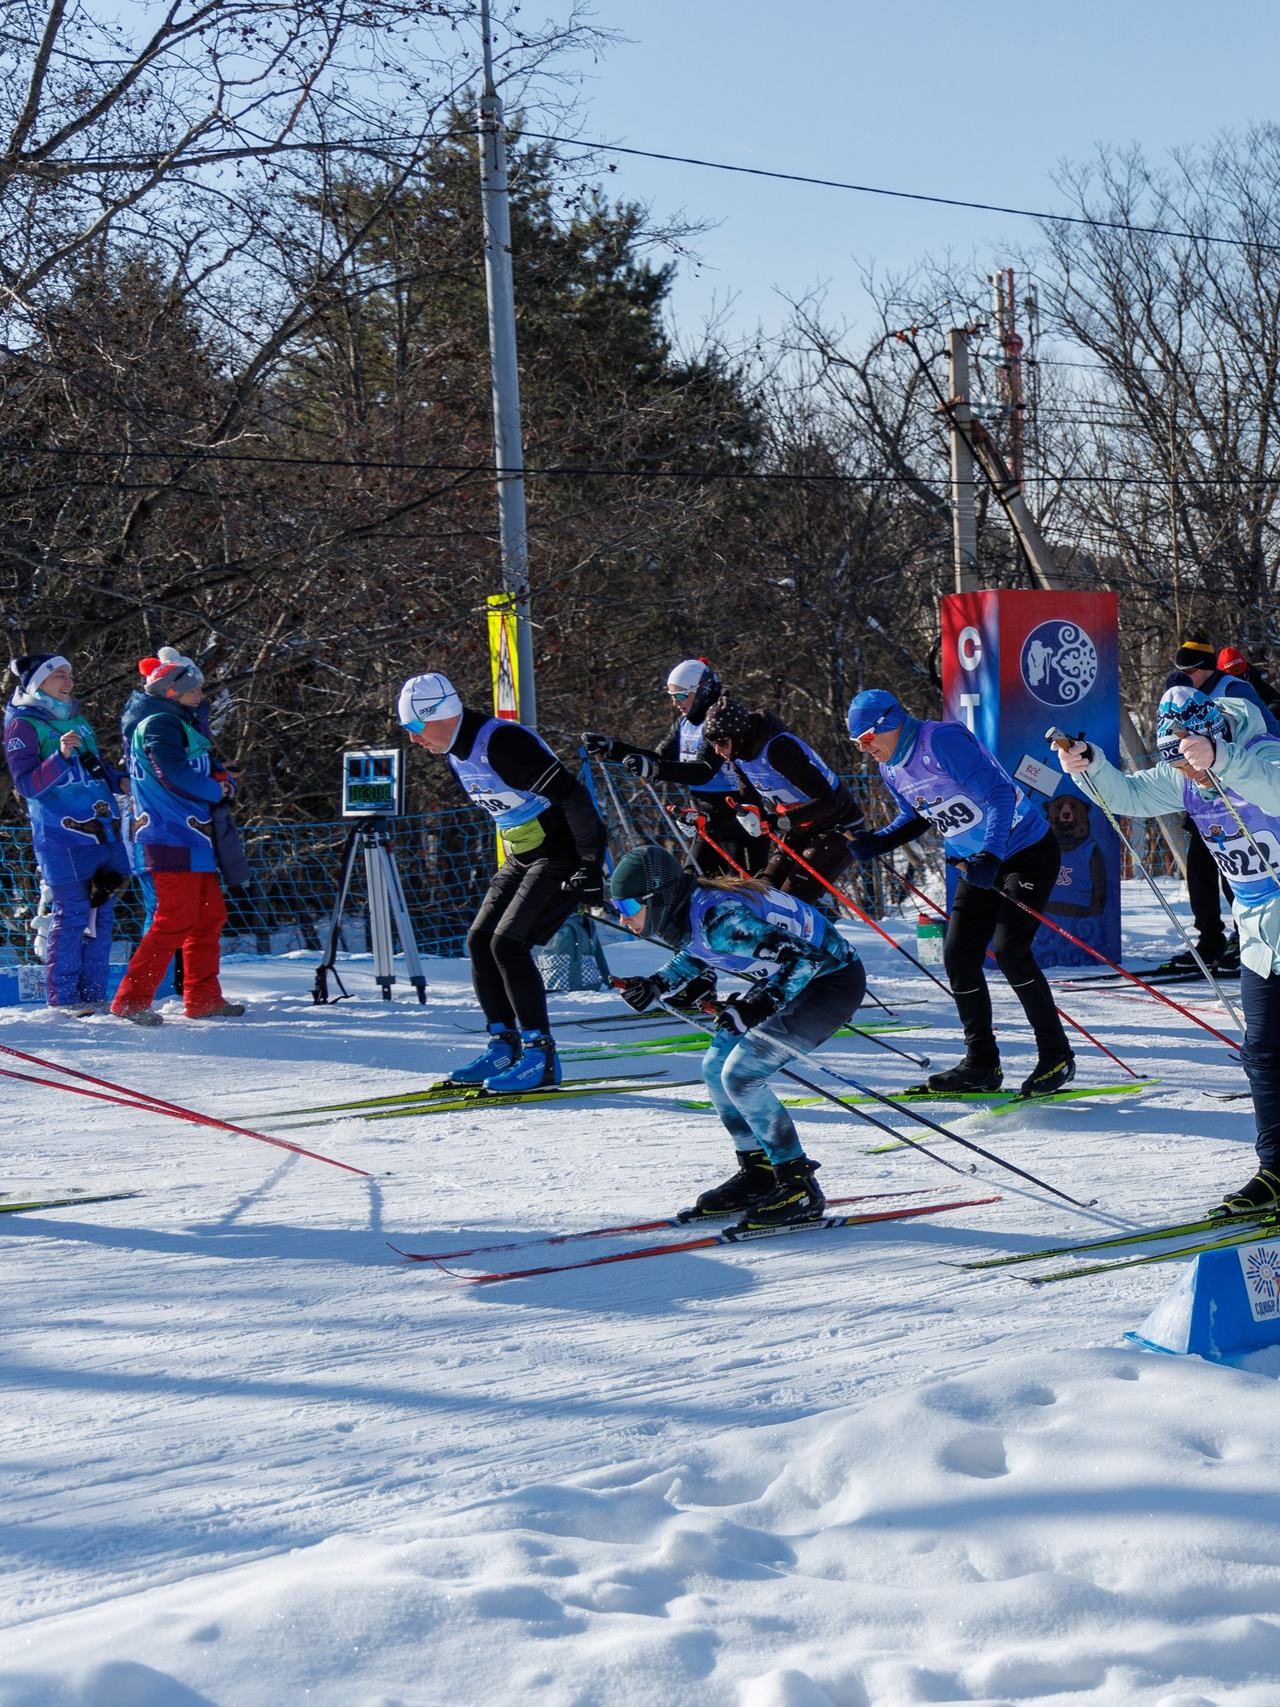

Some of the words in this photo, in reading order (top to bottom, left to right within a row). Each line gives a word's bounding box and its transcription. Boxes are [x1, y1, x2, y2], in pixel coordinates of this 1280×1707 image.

[516, 1062, 545, 1080] SPINE
[465, 1096, 522, 1107] FISCHER
[908, 1094, 963, 1102] FISCHER
[757, 1190, 806, 1213] FISCHER
[788, 1222, 822, 1231] MADSHUS
[742, 1228, 776, 1238] MADSHUS
